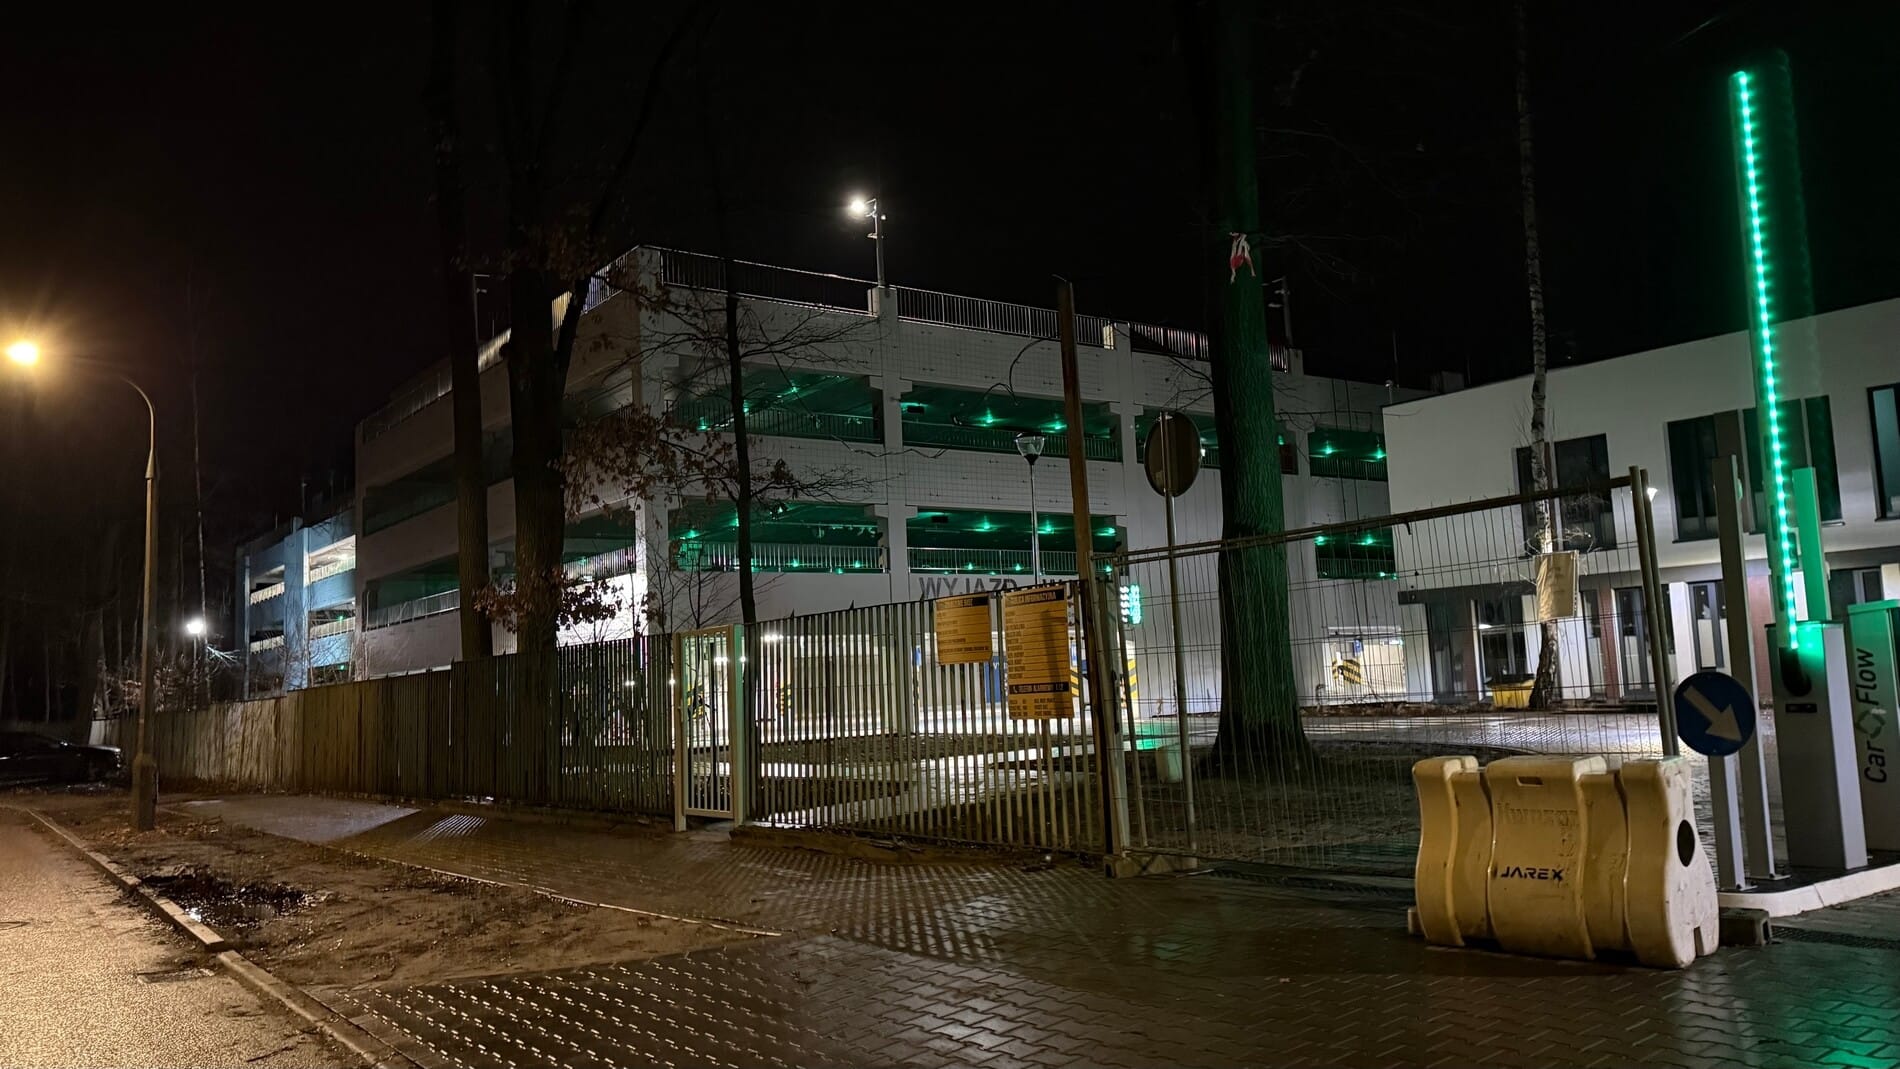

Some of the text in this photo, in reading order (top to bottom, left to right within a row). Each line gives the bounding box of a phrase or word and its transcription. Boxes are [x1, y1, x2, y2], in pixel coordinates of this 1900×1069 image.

[1856, 648, 1887, 783] Car Flow
[1501, 866, 1564, 881] JAREX
